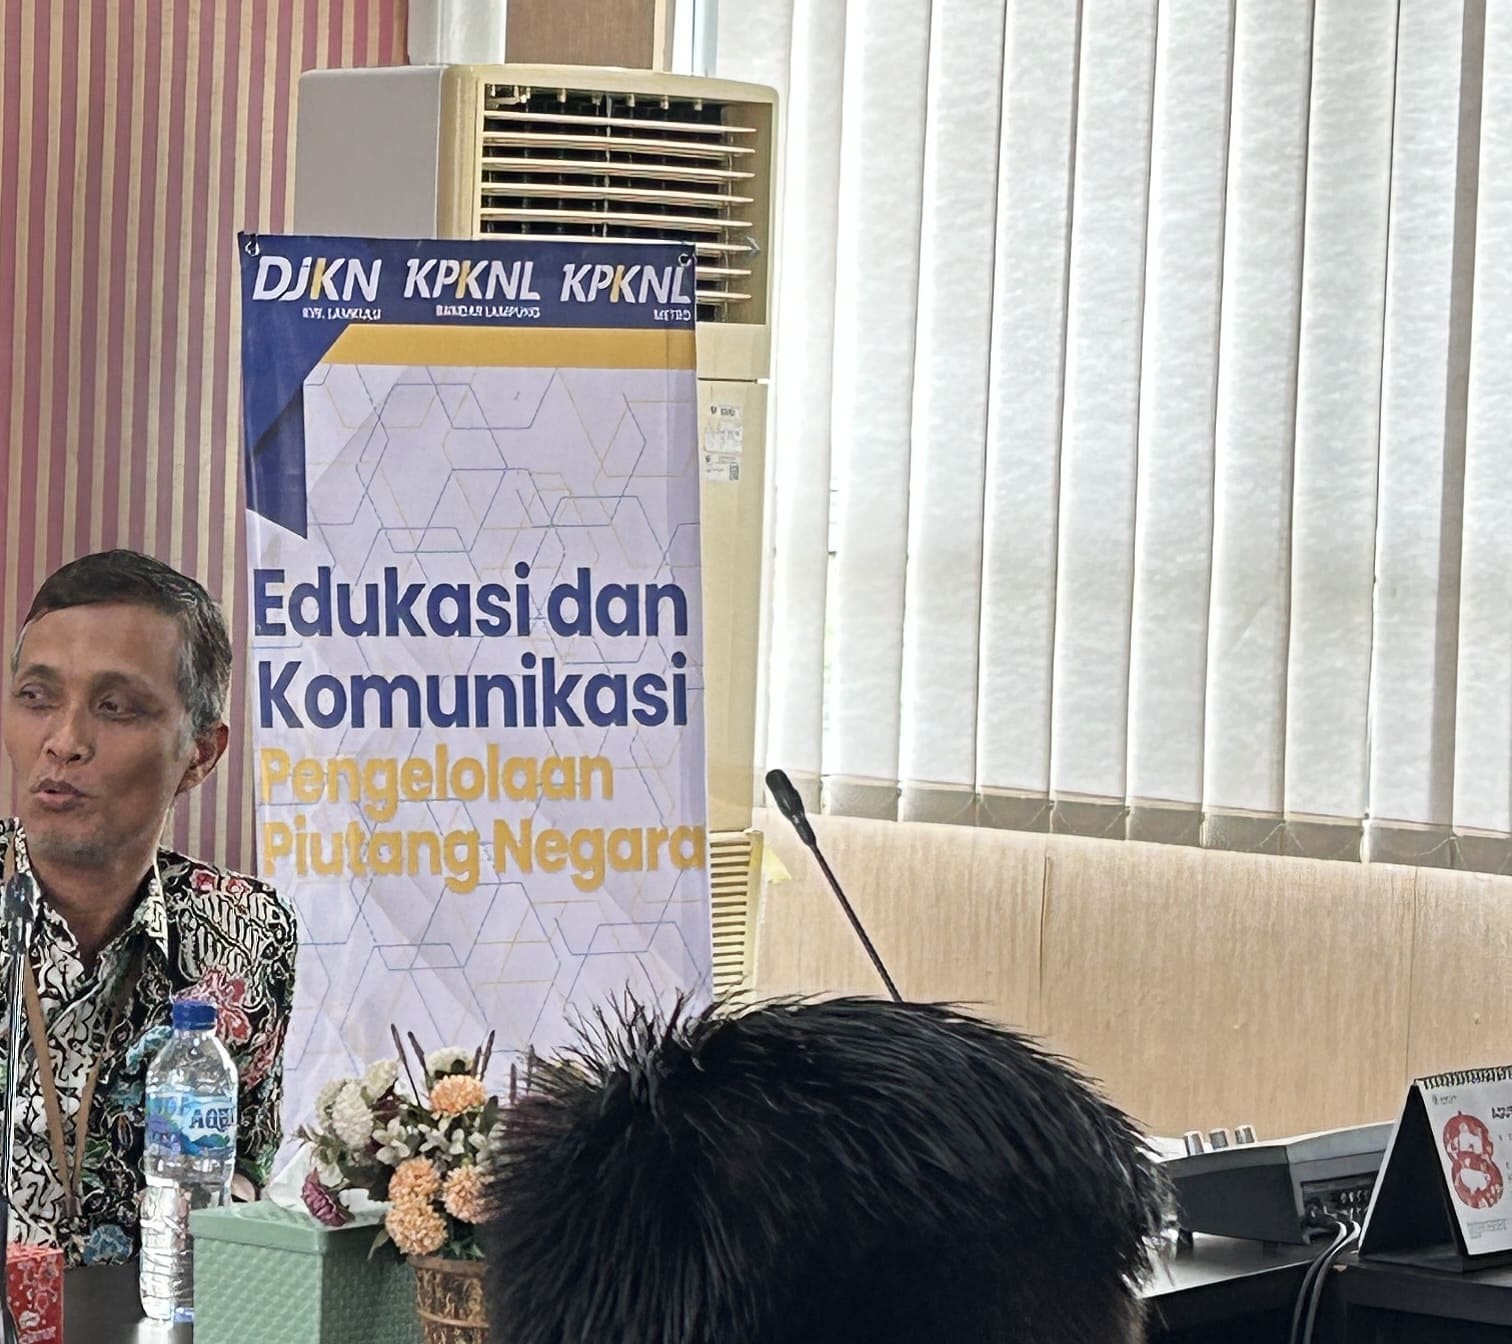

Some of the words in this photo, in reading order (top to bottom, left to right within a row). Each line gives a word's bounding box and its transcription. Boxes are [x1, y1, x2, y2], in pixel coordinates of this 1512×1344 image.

[252, 256, 383, 301] DJKN
[403, 258, 541, 301] KPKNL
[559, 263, 692, 304] KPKNL
[253, 561, 531, 637] Edukasi
[547, 567, 688, 637] dan
[257, 651, 688, 729] Komunikasi
[259, 743, 614, 822] Pengelolaan
[262, 814, 480, 895] Piutang
[493, 818, 706, 893] Negara
